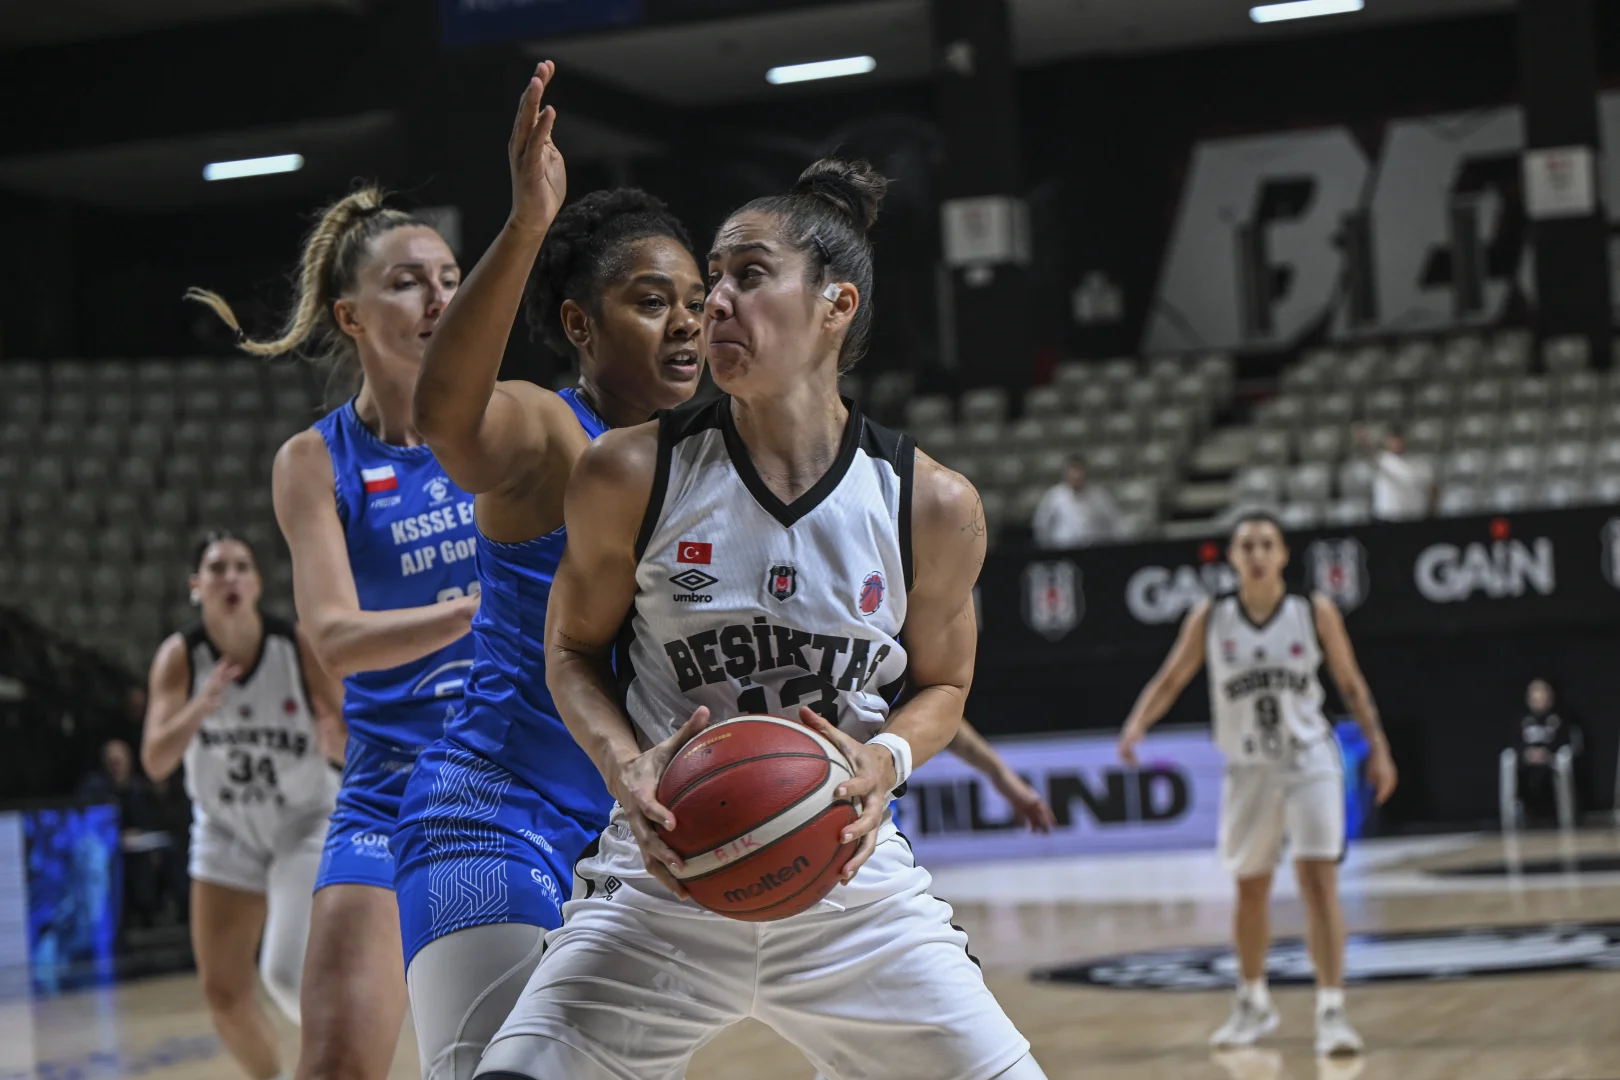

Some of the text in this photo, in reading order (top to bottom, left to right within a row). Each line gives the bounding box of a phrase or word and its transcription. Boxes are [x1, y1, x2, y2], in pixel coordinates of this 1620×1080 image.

[391, 505, 457, 545] KSSSE
[401, 545, 436, 577] AJP
[673, 592, 713, 603] umbro
[228, 749, 277, 788] 34
[723, 855, 810, 904] molten
